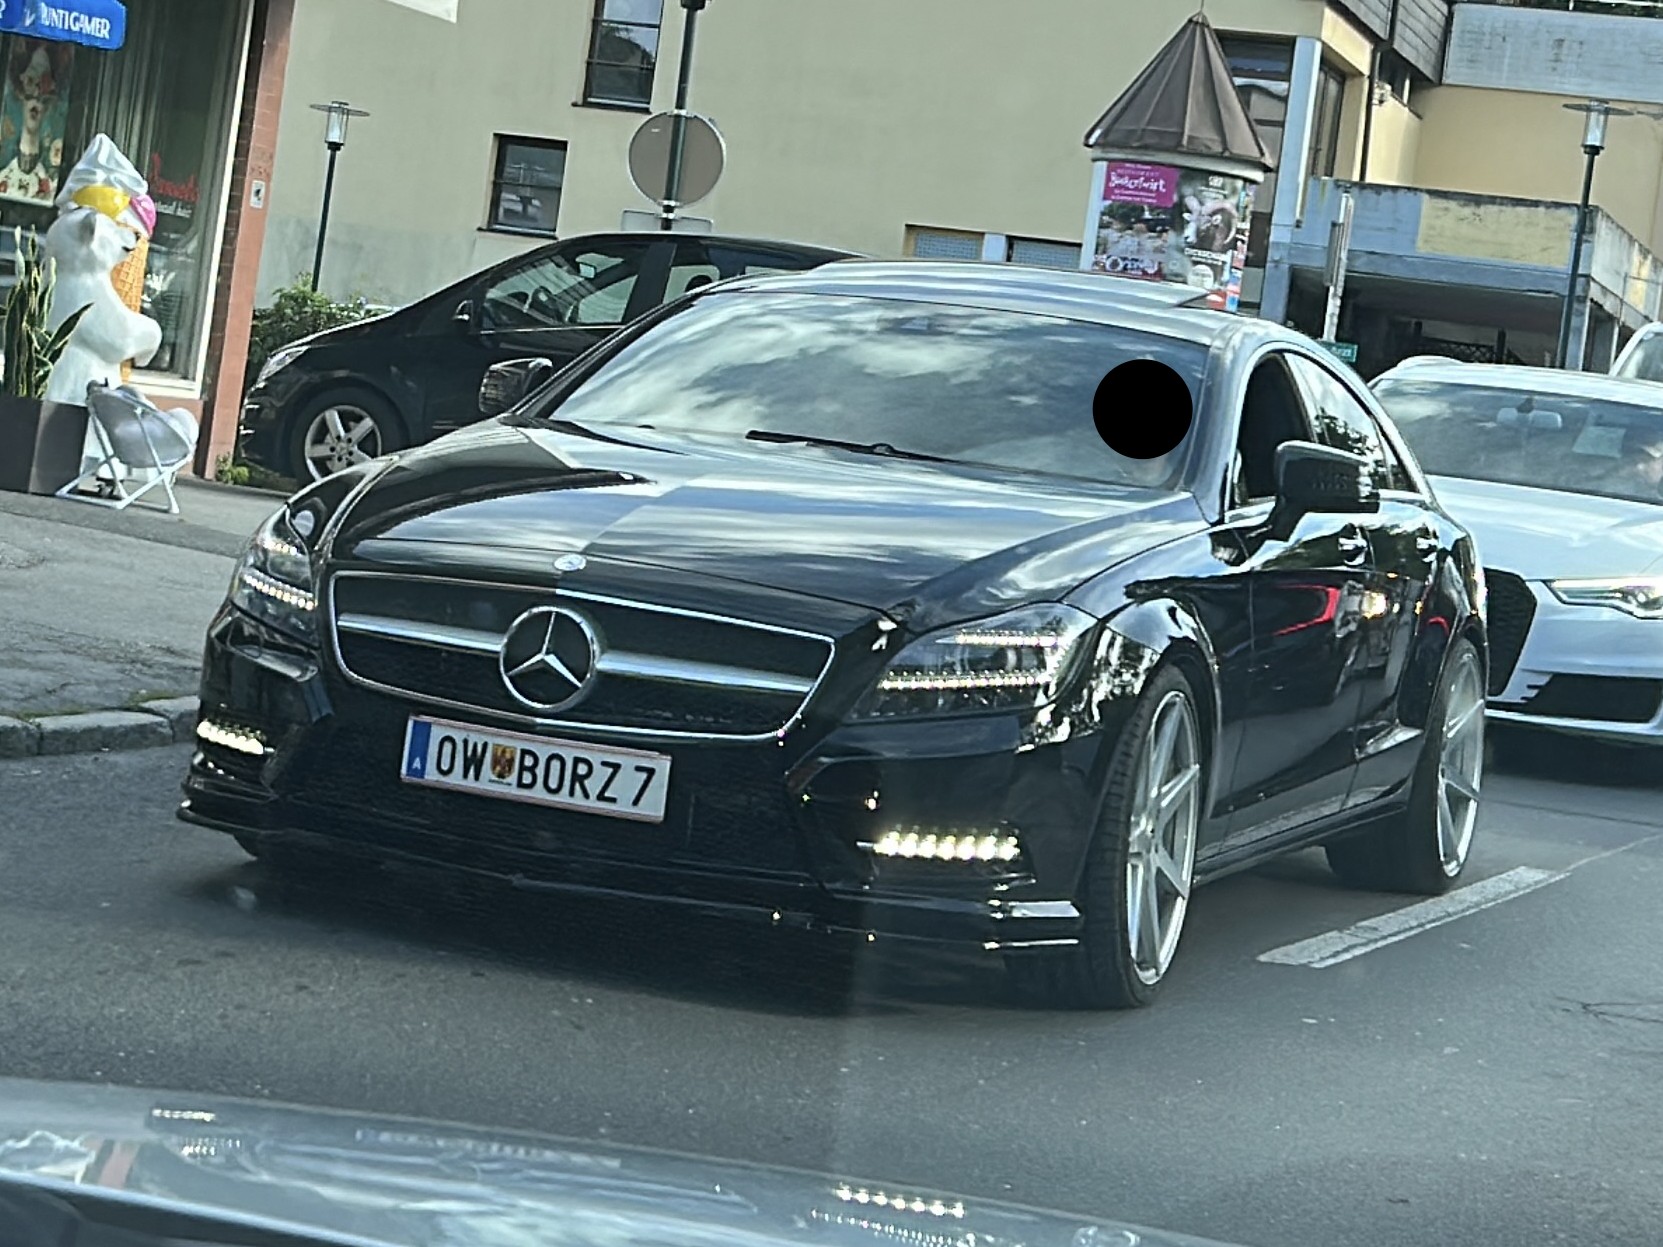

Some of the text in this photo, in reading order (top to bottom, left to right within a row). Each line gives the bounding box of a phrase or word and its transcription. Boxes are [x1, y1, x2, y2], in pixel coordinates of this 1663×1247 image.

[412, 757, 421, 770] A
[436, 735, 656, 806] OW BORZ 7
